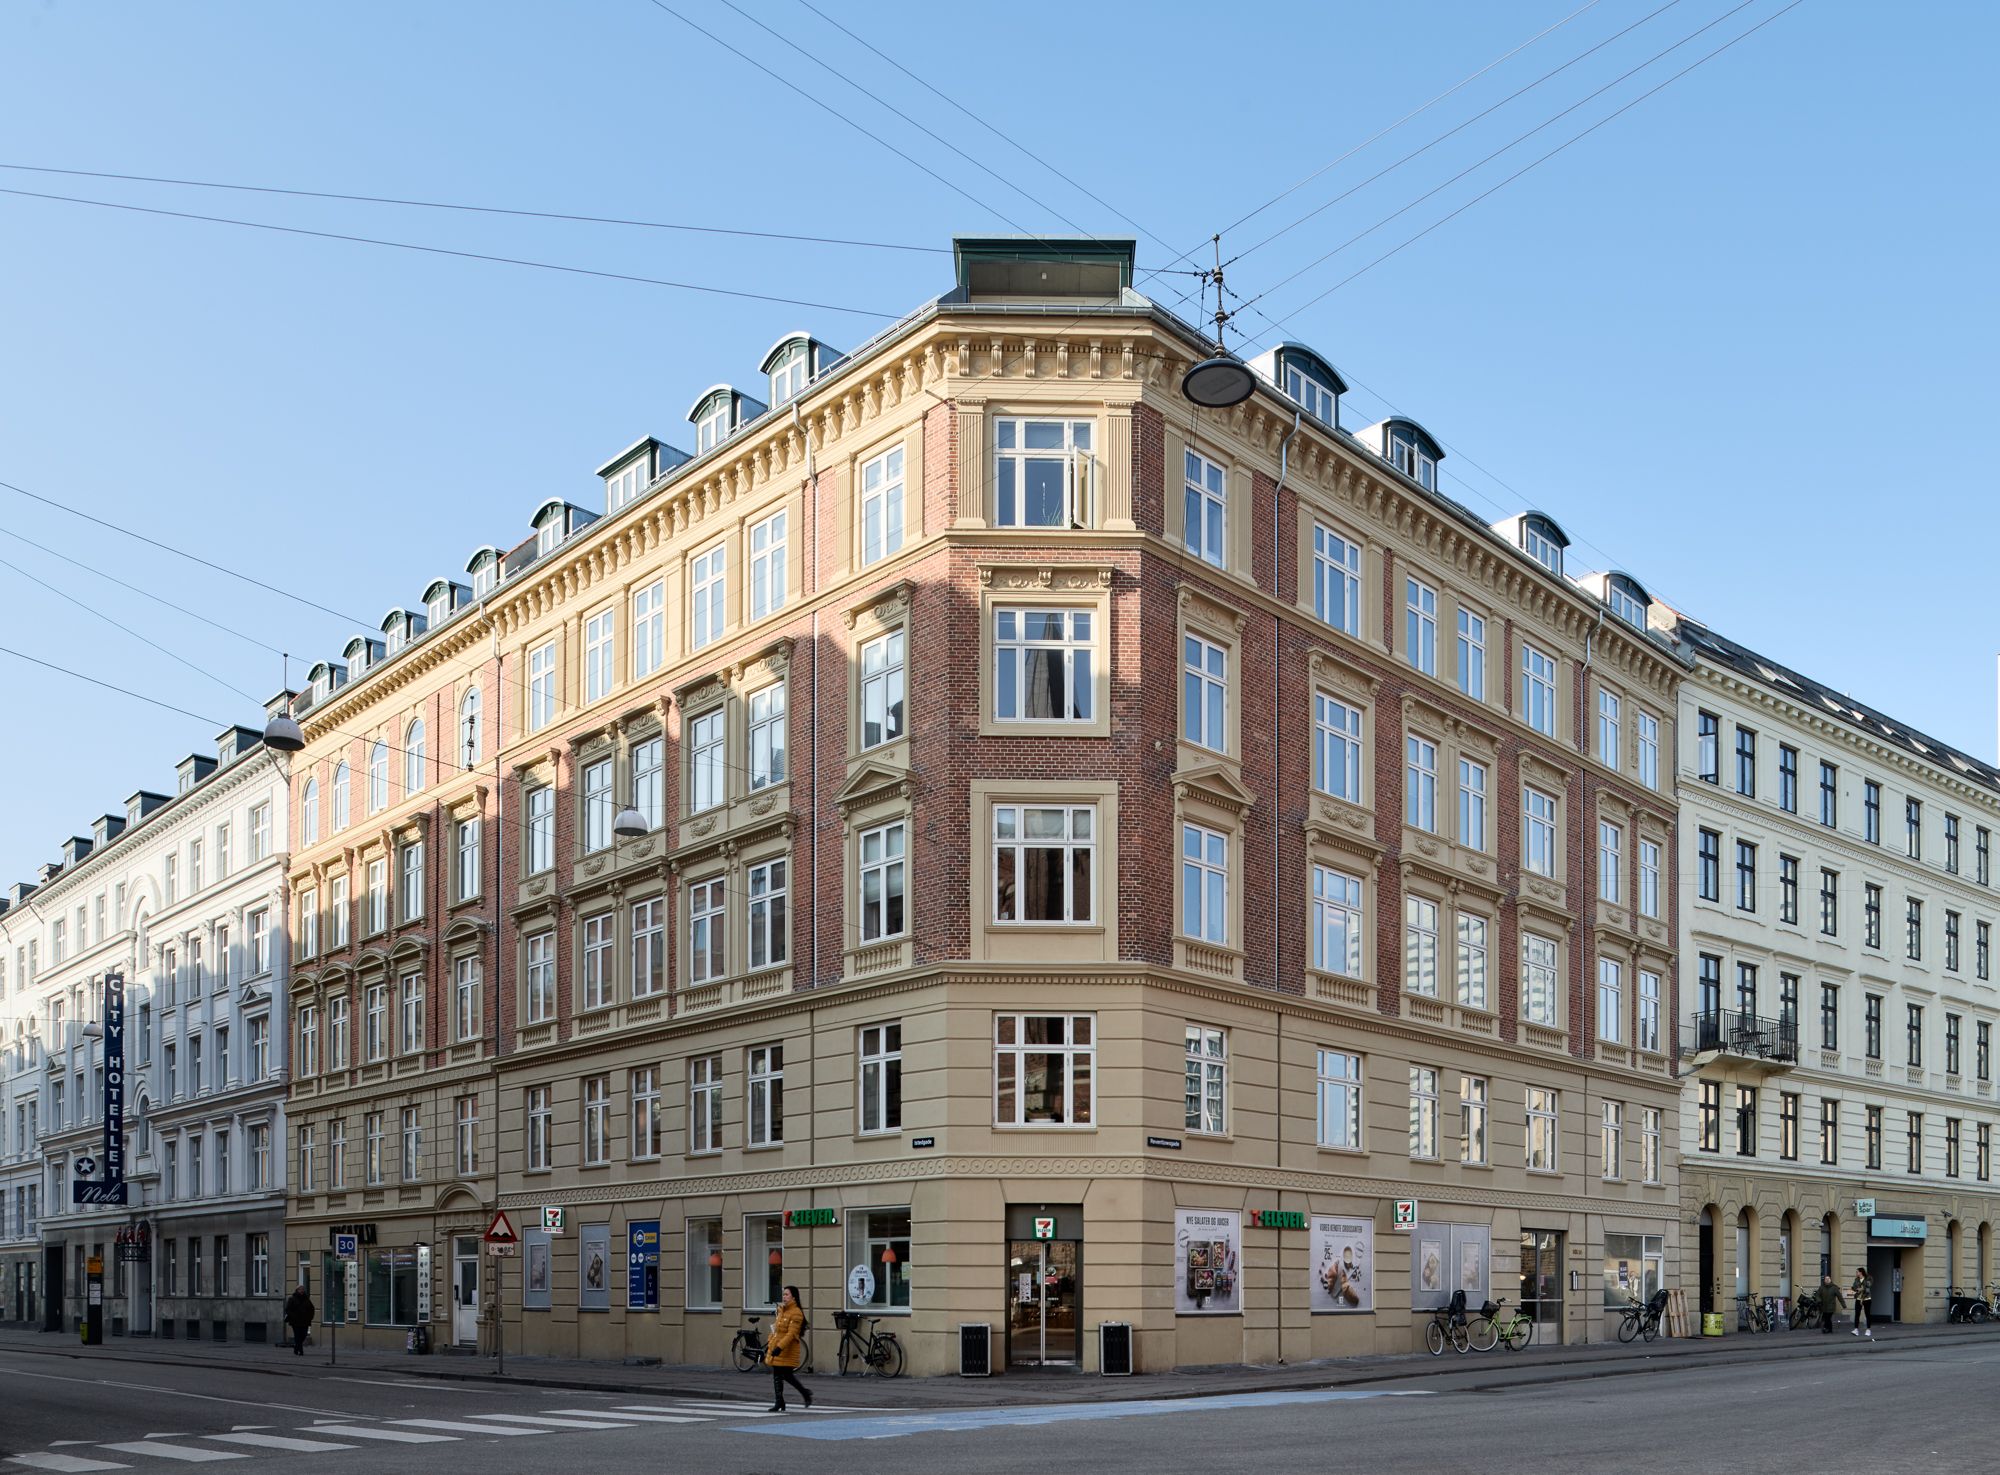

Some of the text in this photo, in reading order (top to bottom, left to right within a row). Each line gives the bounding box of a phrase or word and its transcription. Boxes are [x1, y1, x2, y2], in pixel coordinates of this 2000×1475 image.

[108, 979, 121, 1178] CITY HOTELLET
[81, 1183, 120, 1202] Nebo
[1186, 1216, 1194, 1225] NYE
[340, 1240, 354, 1250] 30
